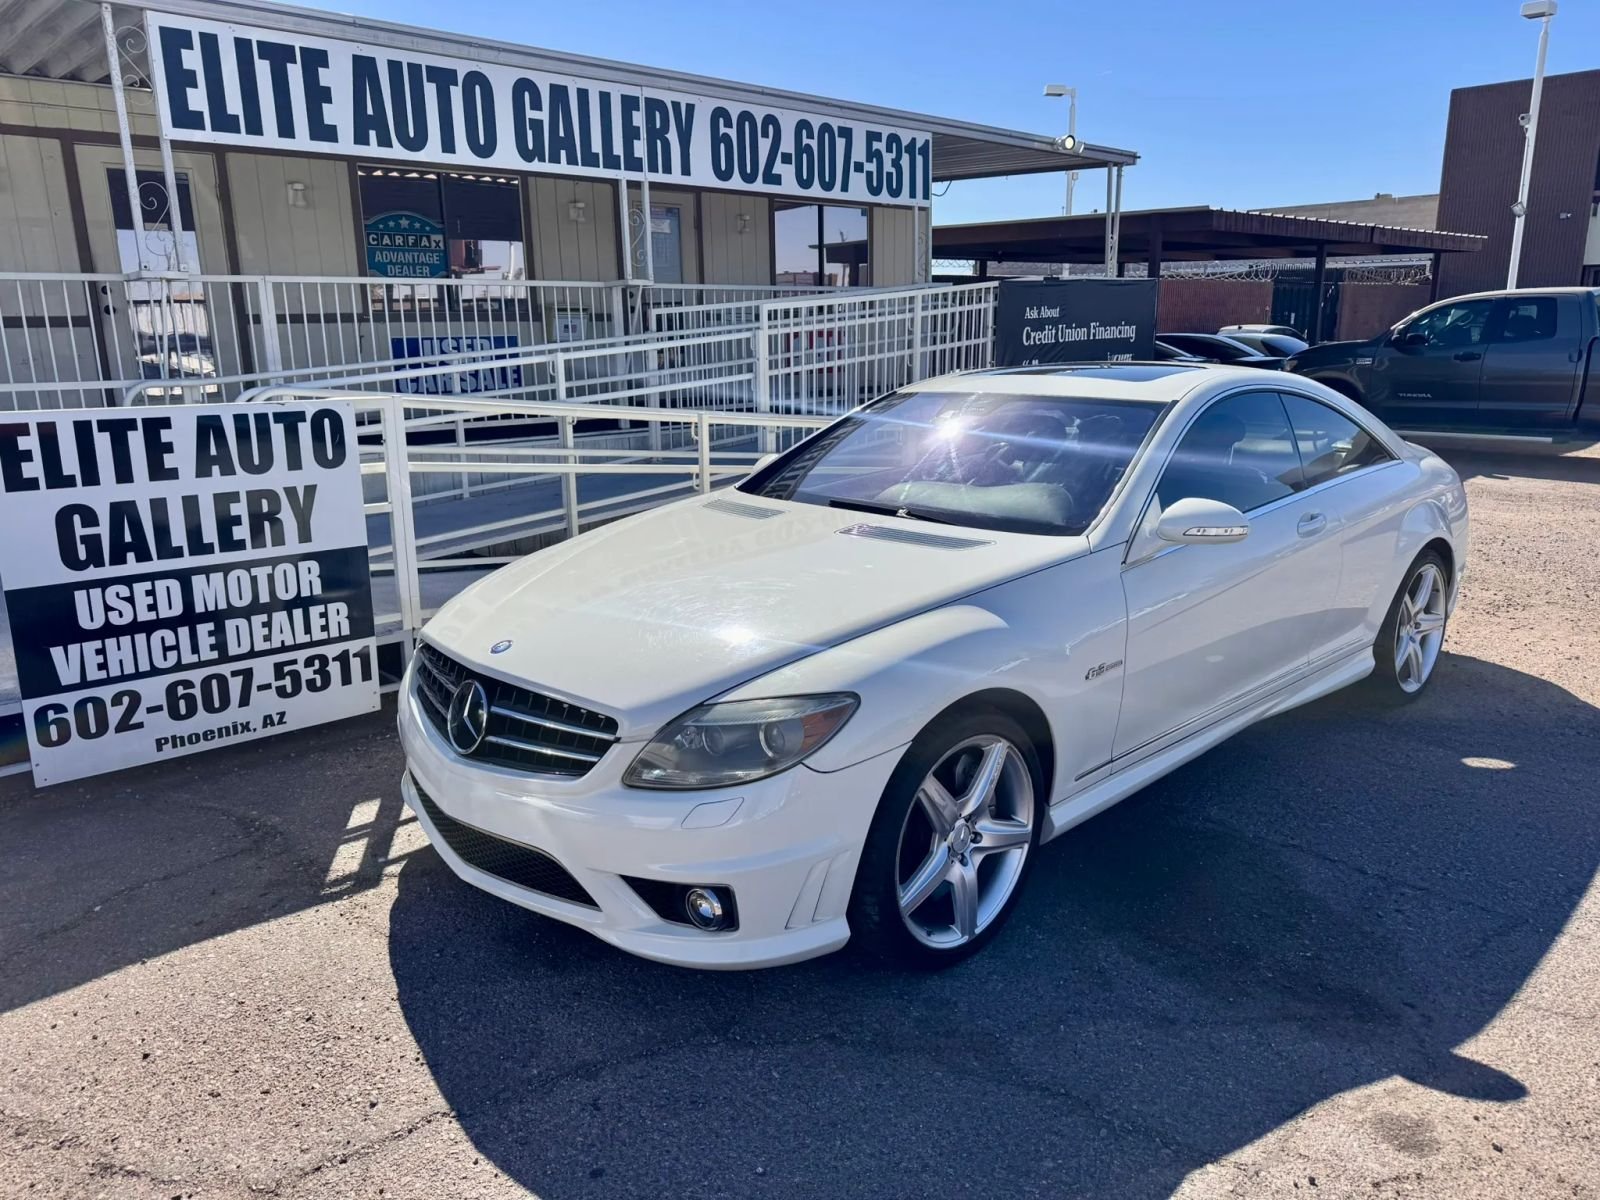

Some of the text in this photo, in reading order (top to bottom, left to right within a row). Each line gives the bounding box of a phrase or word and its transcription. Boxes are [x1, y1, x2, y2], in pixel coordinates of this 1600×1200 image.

[159, 25, 930, 200] ELITE AUTO GALLERY 602-607-5311
[369, 233, 442, 249] CARFAX
[375, 251, 440, 265] ADVANTAGE
[387, 264, 430, 277] DEALER
[1025, 306, 1060, 319] Ask About
[1023, 321, 1136, 346] Credit Union Financing
[423, 338, 492, 366] USED
[460, 365, 519, 391] SALE
[0, 408, 347, 493] ELITE AUTO
[55, 484, 318, 572] GALLERY
[74, 560, 322, 630] USED MOTOR
[50, 601, 350, 687] VEHICLE DEALER
[33, 644, 373, 749] 602-607-5311
[155, 711, 287, 753] Phoenix, AZ
